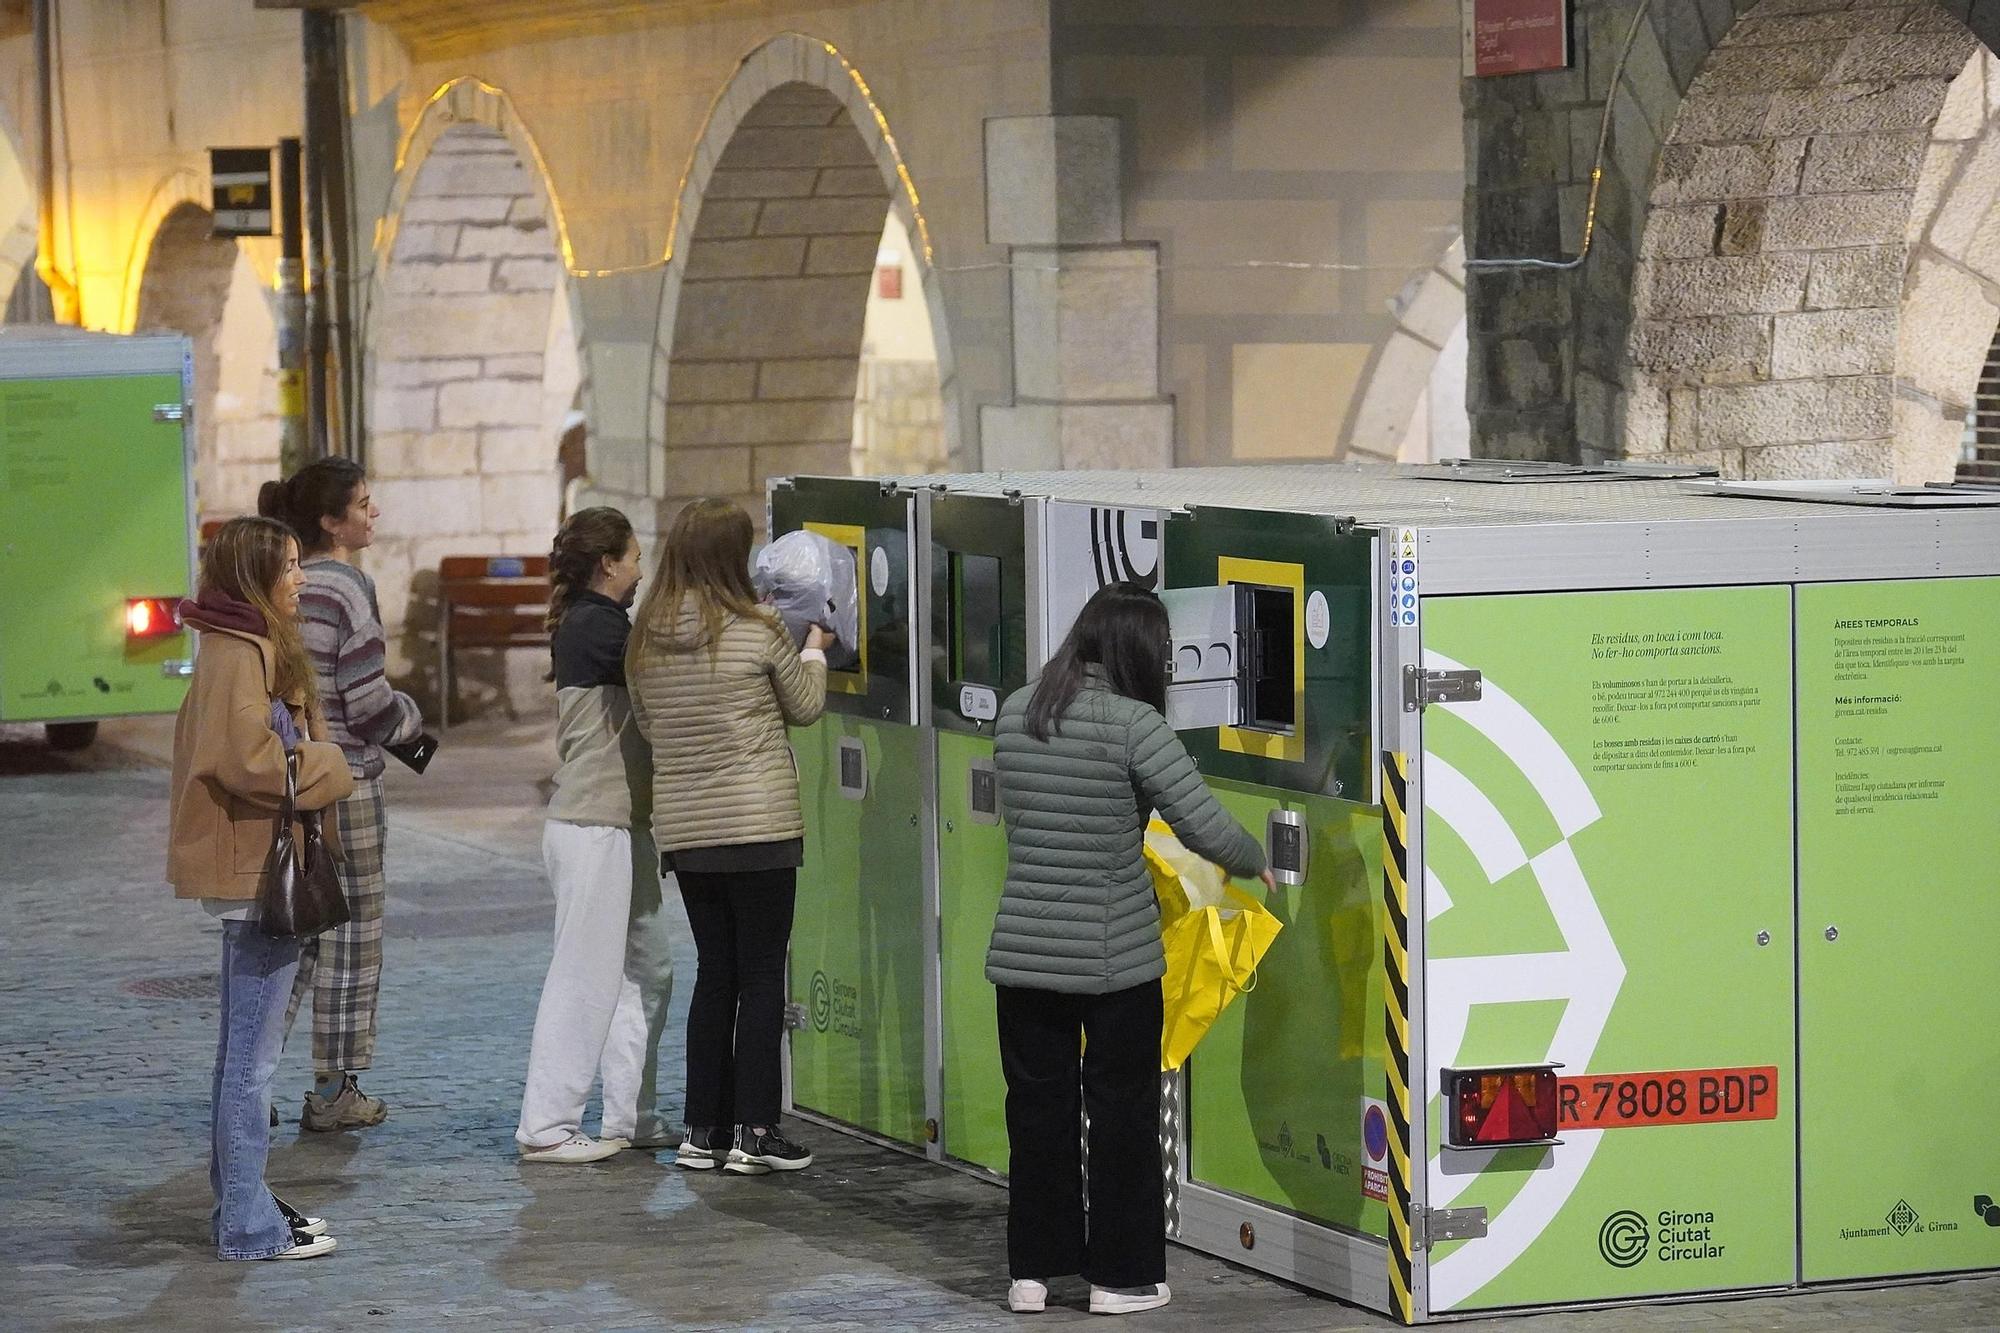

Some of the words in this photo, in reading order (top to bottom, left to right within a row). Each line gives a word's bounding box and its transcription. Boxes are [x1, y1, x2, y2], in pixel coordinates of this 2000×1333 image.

[1834, 618, 1863, 629] ÀREES
[1865, 618, 1919, 628] TEMPORALS
[1592, 634, 1604, 645] Els
[1606, 632, 1640, 644] residus,
[1642, 634, 1654, 642] on
[1656, 632, 1675, 642] toca
[1682, 632, 1700, 641] com
[1702, 630, 1724, 640] toca.
[1592, 648, 1604, 659] No
[1606, 647, 1634, 659] fer-ho
[1636, 646, 1678, 659] comporta
[1680, 644, 1722, 656] sancions.
[1592, 681, 1601, 690] Els
[1602, 679, 1641, 689] voluminosos
[1659, 678, 1667, 687] de
[1668, 678, 1687, 688] portar
[1628, 692, 1646, 700] trucar
[1835, 697, 1853, 705] Més
[1854, 694, 1902, 704] informació:
[1654, 702, 1667, 710] fora
[1668, 702, 1678, 711] pot
[1679, 700, 1710, 710] comportar
[1593, 716, 1600, 724] de
[1593, 740, 1603, 749] Les
[1604, 740, 1624, 748] bosses
[1624, 739, 1638, 747] amb
[1640, 738, 1661, 746] residus
[1675, 736, 1692, 745] caixes
[1694, 736, 1702, 744] de
[1702, 734, 1720, 744] cartró
[1593, 752, 1602, 760] de
[1649, 749, 1659, 758] del
[1732, 745, 1744, 754] fora
[1746, 746, 1756, 755] pot
[1593, 763, 1626, 773] comportar
[1627, 762, 1652, 770] sancions
[1654, 761, 1661, 769] de
[1662, 760, 1674, 768] fins
[1560, 1084, 1581, 1123] R
[1593, 1079, 1687, 1121] 7808
[1700, 1074, 1769, 1115] BDP
[1658, 1210, 1714, 1226] Girona
[1658, 1227, 1711, 1244] Ciutat
[1840, 1226, 1890, 1240] Ajuntament
[1915, 1222, 1925, 1233] de
[1929, 1222, 1958, 1232] Girona
[1658, 1243, 1725, 1261] Circular
